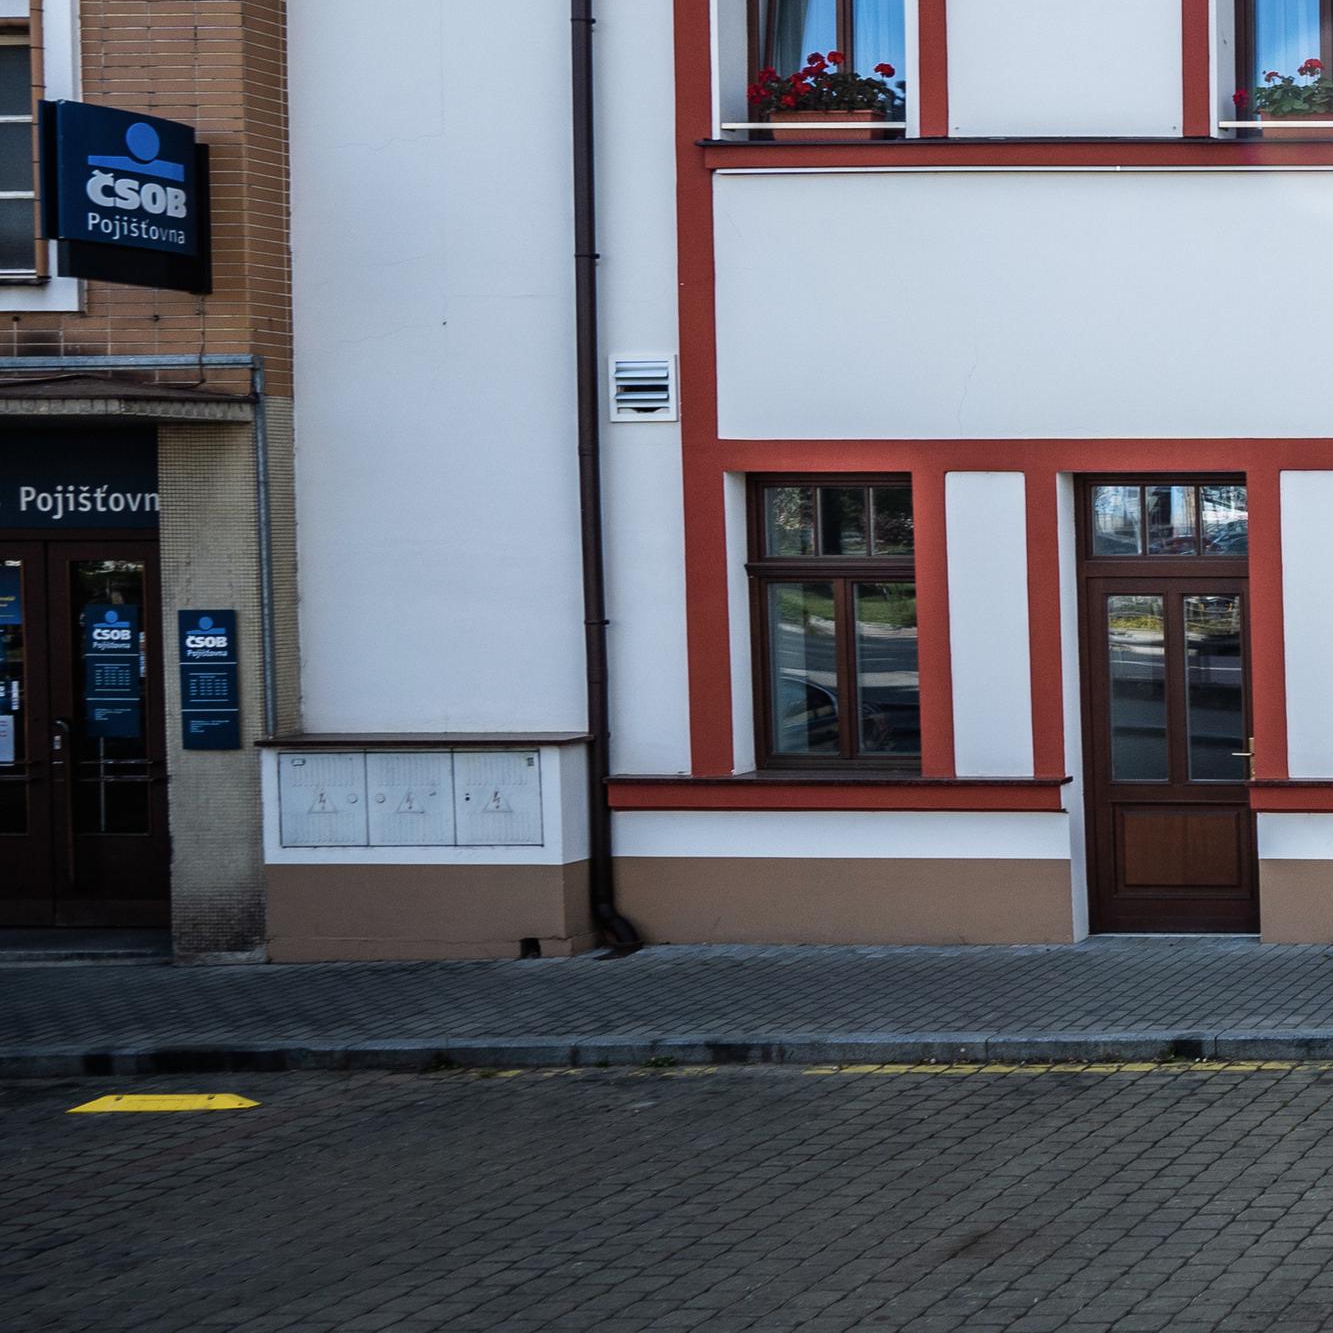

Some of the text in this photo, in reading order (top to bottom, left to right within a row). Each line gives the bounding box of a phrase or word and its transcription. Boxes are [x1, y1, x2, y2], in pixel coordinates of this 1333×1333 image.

[86, 169, 187, 218] ČSOB
[87, 212, 186, 244] Pojišťovna
[92, 628, 132, 641] ČSOB
[185, 635, 229, 648] ČSOB
